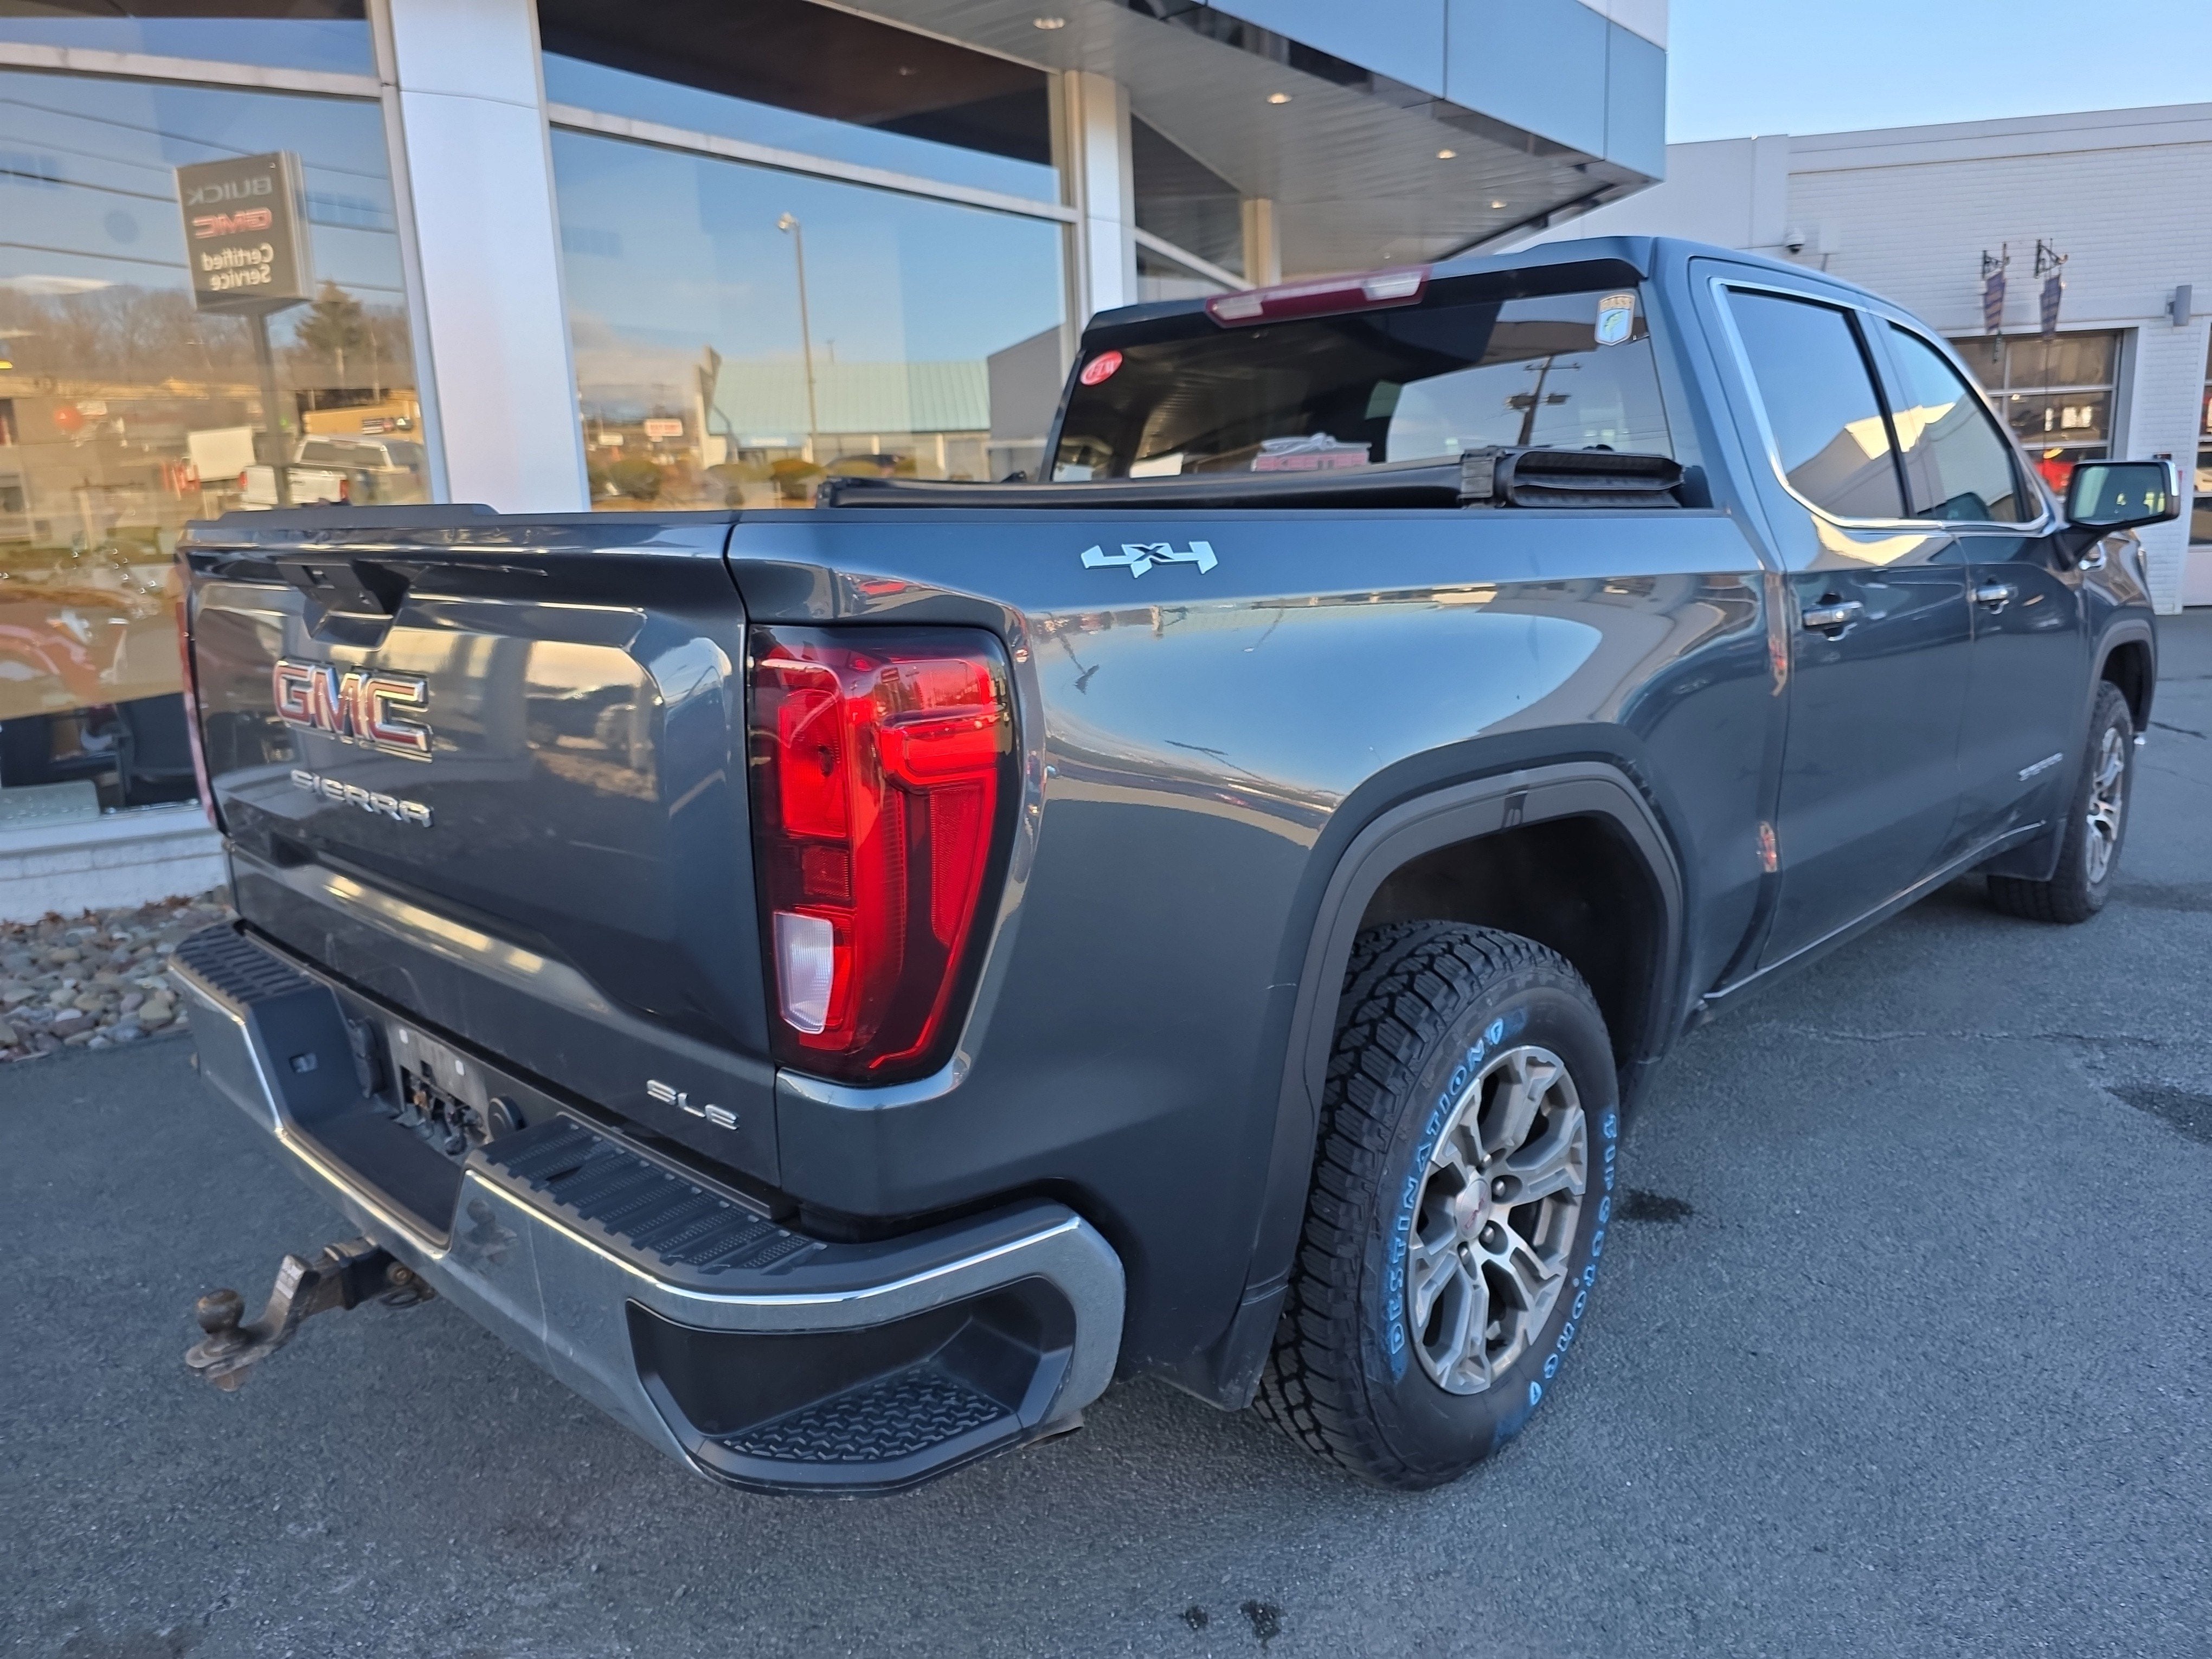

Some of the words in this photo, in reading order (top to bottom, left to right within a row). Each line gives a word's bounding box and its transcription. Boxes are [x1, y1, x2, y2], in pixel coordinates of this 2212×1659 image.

[274, 660, 434, 753] GMC
[291, 769, 434, 828] SIERRA
[646, 1079, 740, 1130] SLE
[1389, 1037, 1486, 1355] DESTINATION
